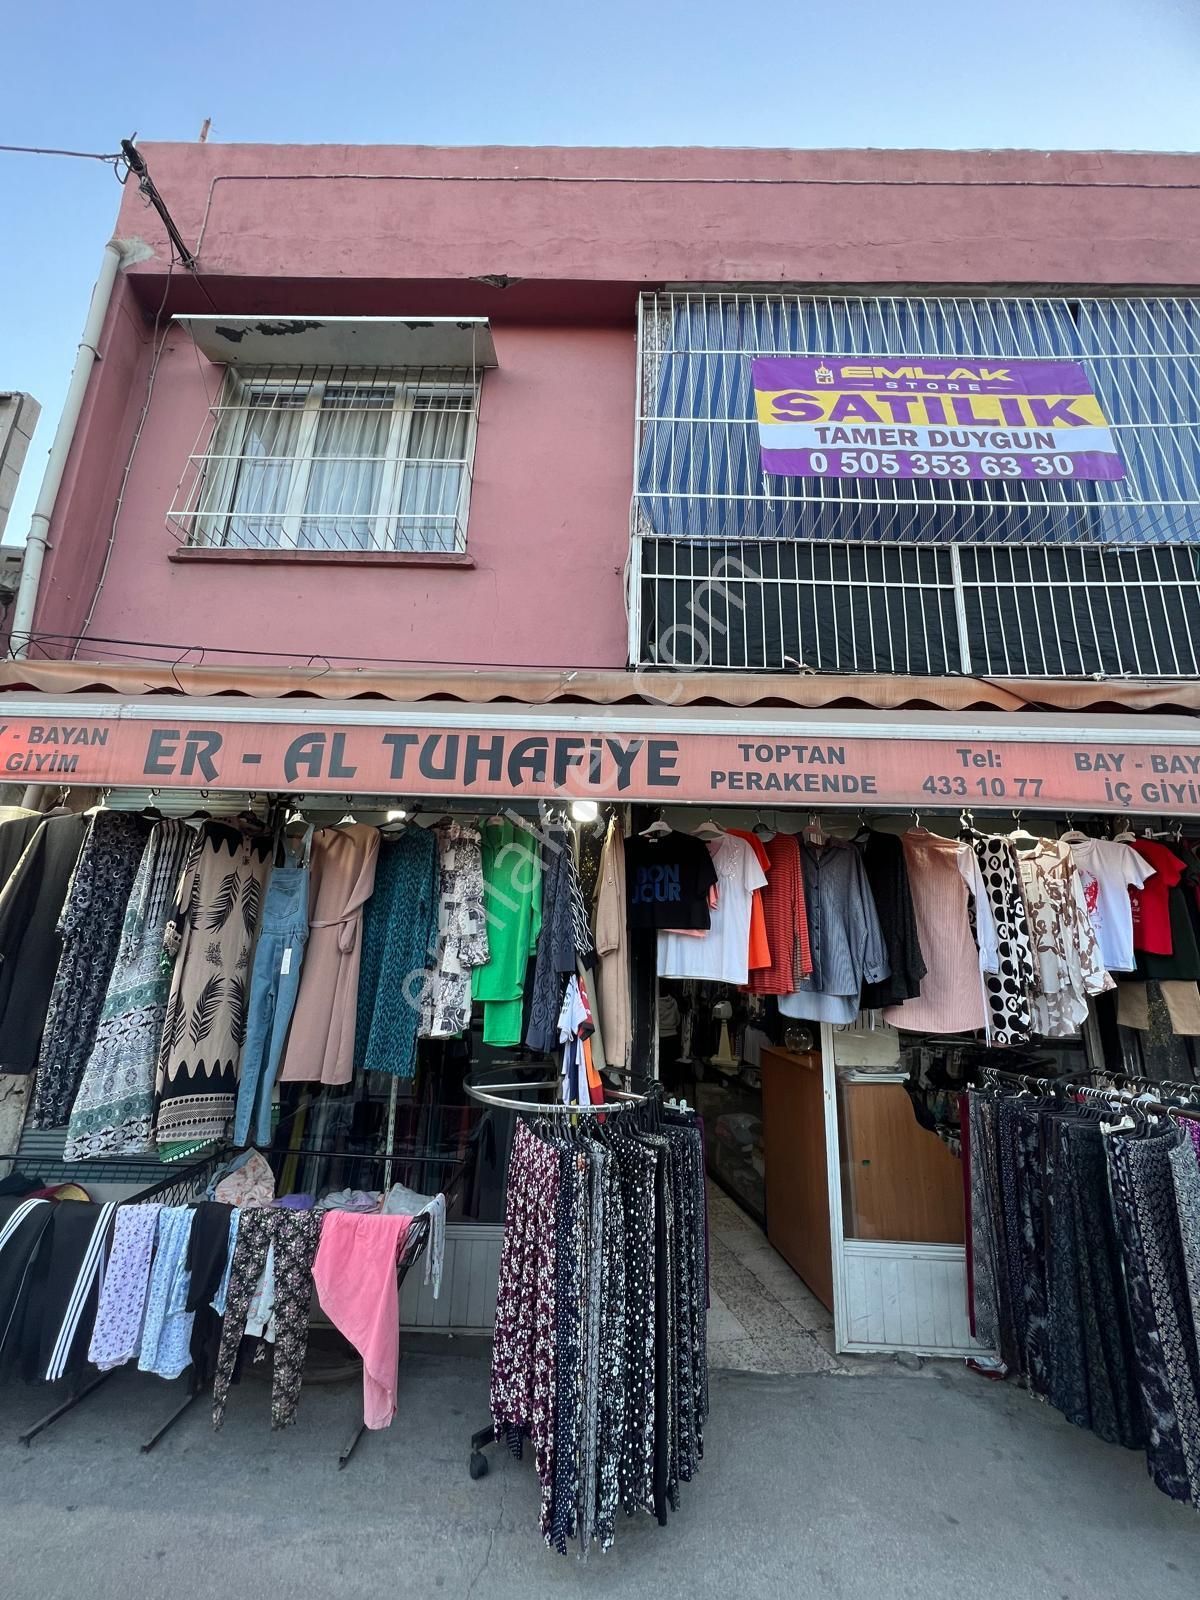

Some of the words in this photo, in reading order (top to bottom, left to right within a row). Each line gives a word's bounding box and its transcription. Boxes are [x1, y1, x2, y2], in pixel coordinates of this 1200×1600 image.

[840, 366, 1015, 382] EMLAK
[886, 382, 980, 391] STORE
[771, 392, 1094, 426] SATILIK
[815, 426, 920, 447] TAMER
[928, 429, 1056, 449] DUYGUN
[809, 452, 828, 472] 0
[840, 451, 900, 473] 505
[909, 453, 971, 475] 353
[980, 456, 1021, 476] 63
[1034, 455, 1074, 476] 30
[28, 726, 109, 745] BAYAN
[6, 750, 79, 773] GİYİM
[143, 729, 223, 783] ER
[284, 732, 357, 783] AL
[382, 733, 681, 791] TUHAFİYE
[738, 744, 846, 765] TOPTAN
[956, 748, 1002, 769] Tel:
[1074, 753, 1125, 772] BAY
[710, 771, 878, 794] PERAKENDE
[922, 775, 968, 796] 433
[976, 777, 1004, 797] 10
[1013, 778, 1044, 798] 77
[1105, 777, 1133, 807] İÇ
[1141, 779, 1200, 804] GİYİ
[637, 864, 680, 882] BON
[631, 882, 681, 903] JOUR
